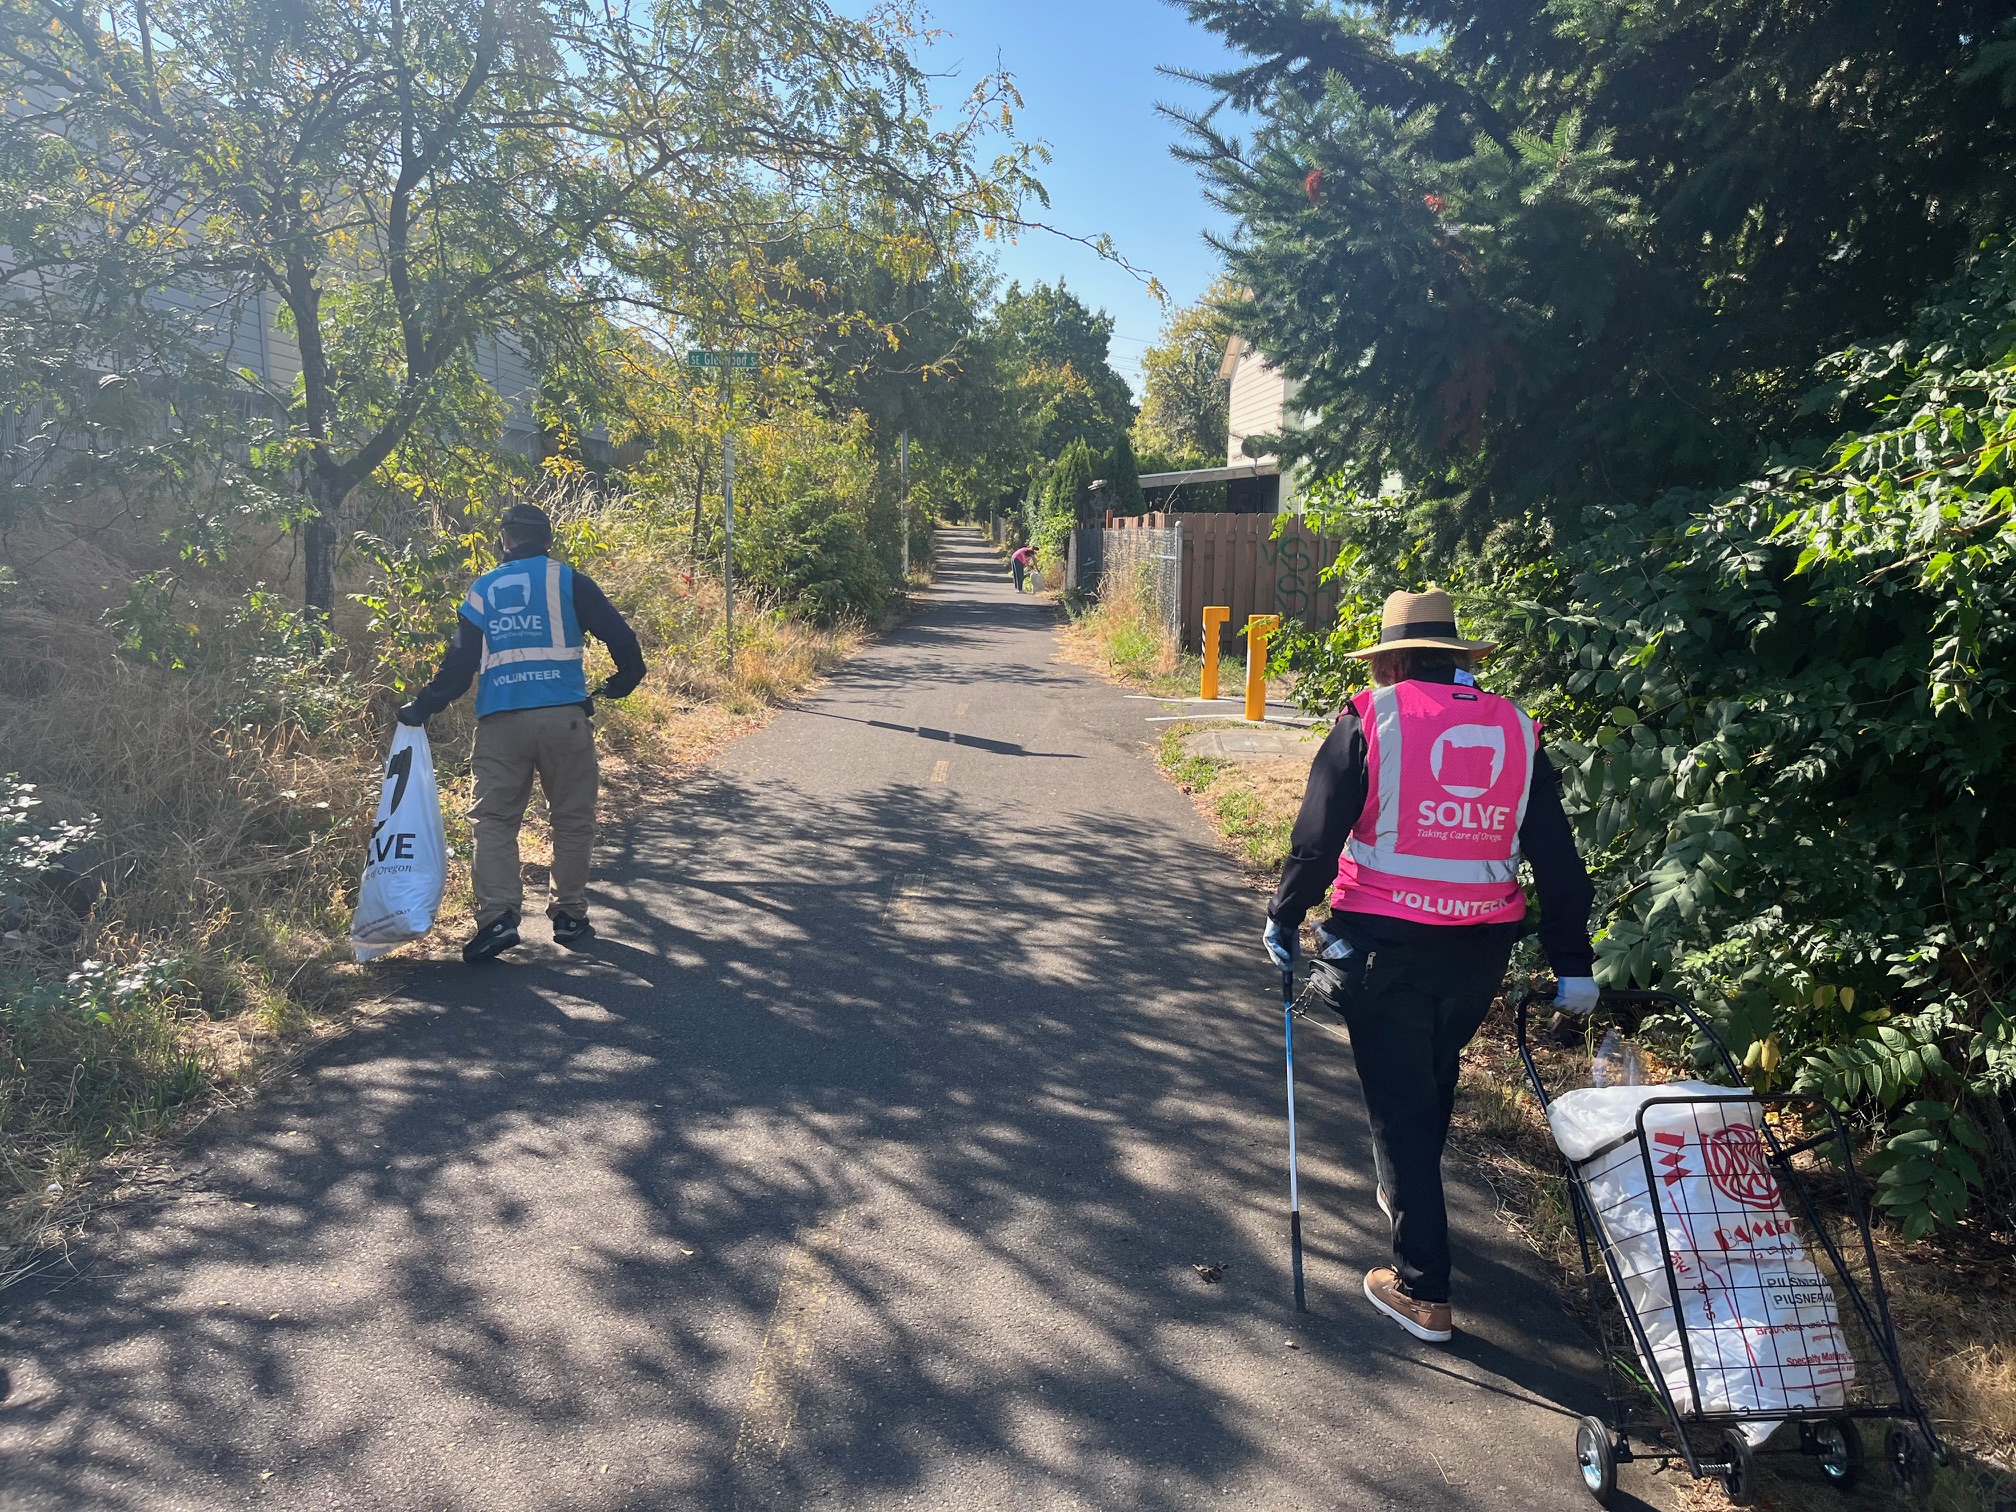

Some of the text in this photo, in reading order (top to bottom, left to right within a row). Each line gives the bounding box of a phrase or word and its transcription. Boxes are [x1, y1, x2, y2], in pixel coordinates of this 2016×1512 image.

[691, 355, 700, 365] SE
[704, 353, 747, 366] Gleood
[489, 615, 542, 634] SOLVE
[493, 669, 561, 686] VOLUNTEER
[1417, 800, 1510, 830] SOLVE
[1417, 829, 1448, 840] Taking
[1449, 831, 1471, 840] Care
[1472, 832, 1481, 842] of
[377, 865, 412, 875] Oregon
